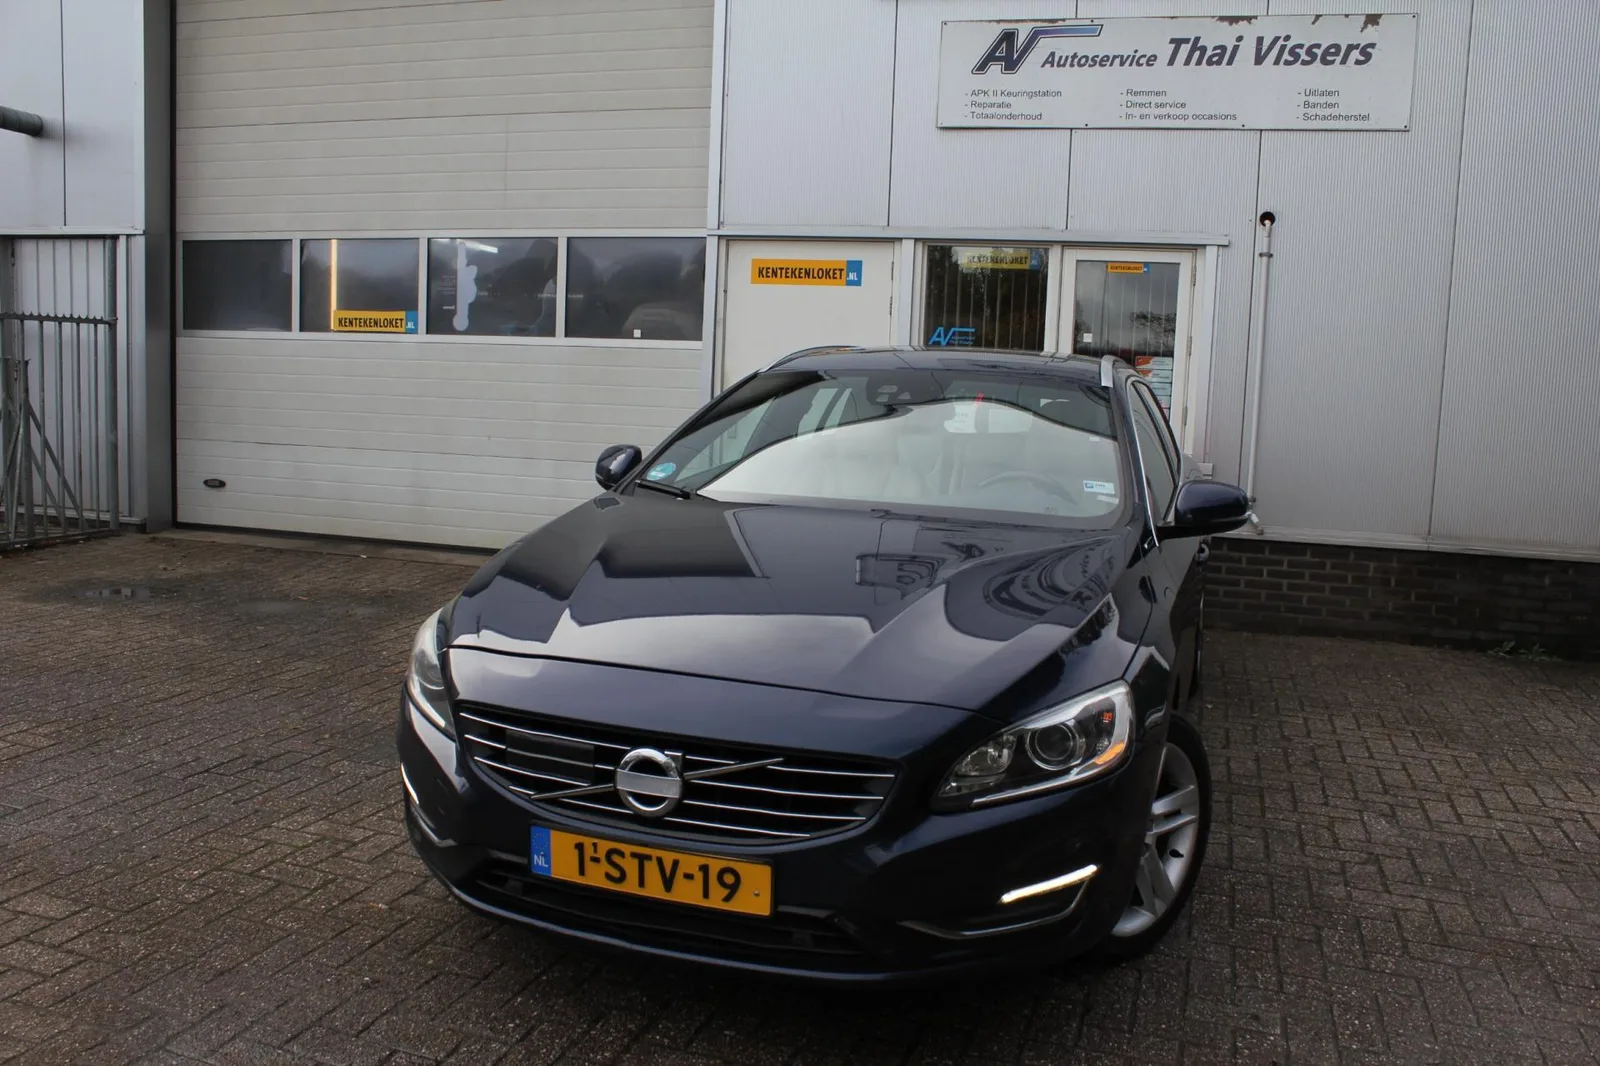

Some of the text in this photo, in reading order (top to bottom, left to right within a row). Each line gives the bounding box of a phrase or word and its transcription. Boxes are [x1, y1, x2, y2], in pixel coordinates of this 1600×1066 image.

[1041, 34, 1377, 68] Autoservice Thai Vissers
[970, 89, 990, 98] APK
[1000, 89, 1062, 100] Keuringstation
[1126, 88, 1167, 97] Remmen
[1304, 88, 1340, 97] Uitlaten
[970, 100, 1012, 110] Reparatie
[1125, 100, 1187, 109] Direct service
[1303, 100, 1340, 109] Banden
[970, 111, 1043, 120] Totaalonderhoud
[1153, 111, 1190, 122] verkoop
[1191, 113, 1237, 121] occasions
[1302, 112, 1370, 122] Schadeherstel
[533, 854, 549, 868] NL
